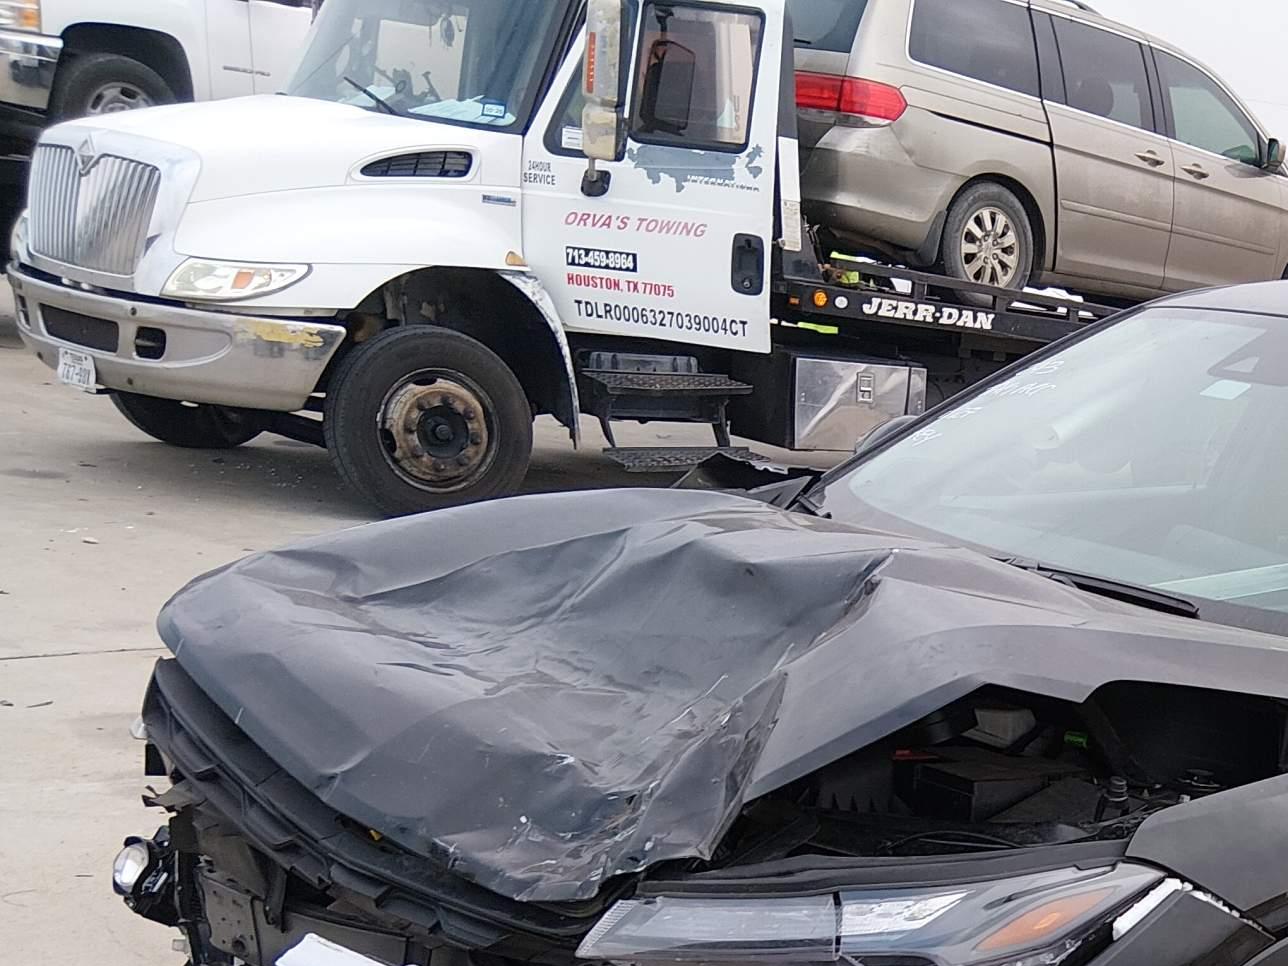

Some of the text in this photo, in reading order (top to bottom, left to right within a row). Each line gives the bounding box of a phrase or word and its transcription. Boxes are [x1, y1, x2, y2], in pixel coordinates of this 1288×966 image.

[523, 172, 556, 185] SERVICE
[564, 211, 708, 238] ORVA'S TOWING
[566, 248, 634, 270] 713-459-8964
[566, 272, 675, 298] HOUSTON, TX 77075
[574, 299, 748, 337] TDLR0006327039004CT
